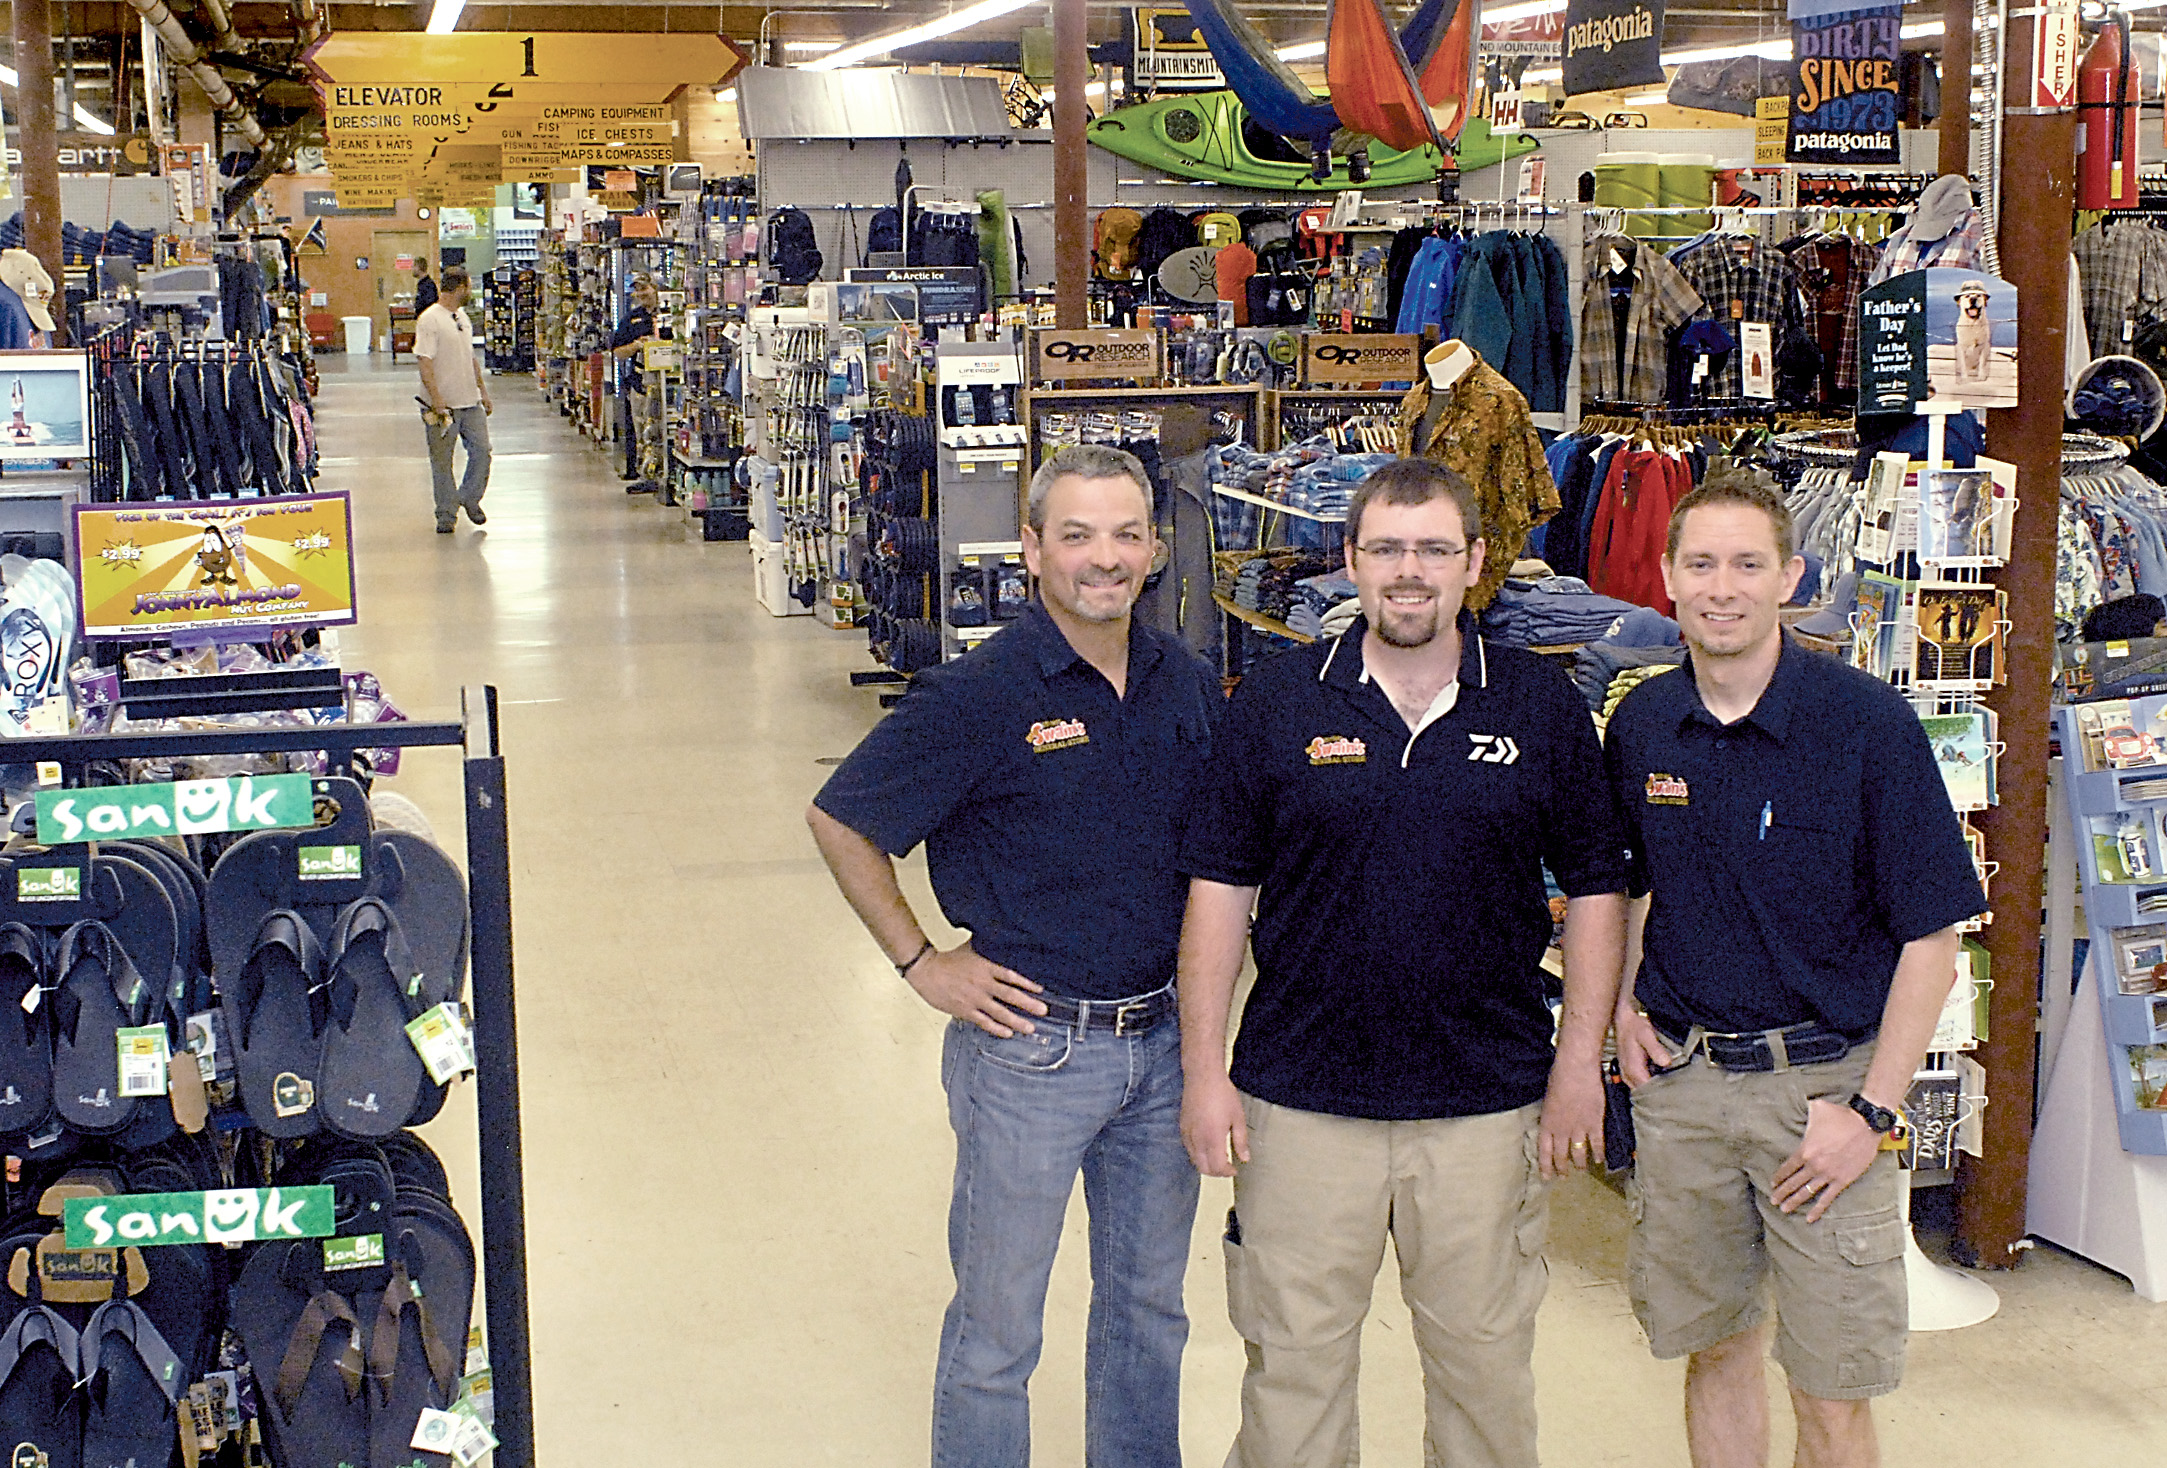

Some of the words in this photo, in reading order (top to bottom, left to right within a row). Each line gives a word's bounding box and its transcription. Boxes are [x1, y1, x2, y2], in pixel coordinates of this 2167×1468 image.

[1567, 6, 1653, 57] patagonia
[1801, 18, 1901, 60] DIRTY
[1500, 43, 1550, 52] MOUNTAIN
[520, 36, 539, 77] 1
[2053, 17, 2067, 95] ISHER
[1797, 58, 1899, 113] SINCE
[336, 87, 442, 106] ELEVATOR
[544, 107, 595, 119] CAMPING
[601, 107, 665, 119] EQUIPMENT
[1493, 99, 1519, 128] HH
[1765, 101, 1789, 113] BACKPA
[1816, 91, 1896, 131] 1973
[333, 115, 402, 129] DRESSING
[413, 113, 461, 127] ROOMS
[502, 129, 523, 138] GUN
[577, 128, 595, 140] ICE
[605, 128, 653, 139] CHESTS
[1758, 125, 1785, 138] SLEEPING
[335, 140, 369, 150] JEANS
[376, 140, 382, 149] &
[386, 140, 413, 150] HATS
[504, 142, 538, 150] FISHING
[1794, 132, 1892, 153] patagonia
[509, 156, 560, 164] DOWNRIGGE
[561, 149, 593, 160] MAPS
[597, 150, 603, 159] &
[606, 149, 673, 160] COMPASSES
[1758, 149, 1774, 160] BACK
[338, 174, 372, 182] SMOKERS
[381, 174, 403, 182] CHIPS
[528, 171, 554, 180] AMMO
[368, 188, 399, 196] MAKING
[903, 272, 929, 280] Arctic
[931, 272, 944, 280] Ice
[1864, 297, 1921, 316] Father's
[1880, 317, 1906, 334] Day
[1045, 341, 1096, 363] OR
[1097, 343, 1150, 353] OUTDOOR
[1877, 343, 1890, 354] Let
[1892, 342, 1907, 352] Dad
[1095, 352, 1151, 361] RESEARCH
[1315, 345, 1362, 365] OR
[1363, 348, 1411, 357] OUTDOOR
[1872, 354, 1895, 363] know
[1896, 352, 1913, 362] he's
[1881, 361, 1911, 373] keeper!
[294, 536, 331, 549] $2.99
[101, 547, 142, 561] $2.99
[230, 604, 253, 615] NUT
[255, 600, 309, 613] COMPANY
[14, 620, 42, 697] ROXY
[1030, 718, 1087, 746] Swain's
[1310, 736, 1366, 759] Swain's
[1918, 1119, 1944, 1159] DADS
